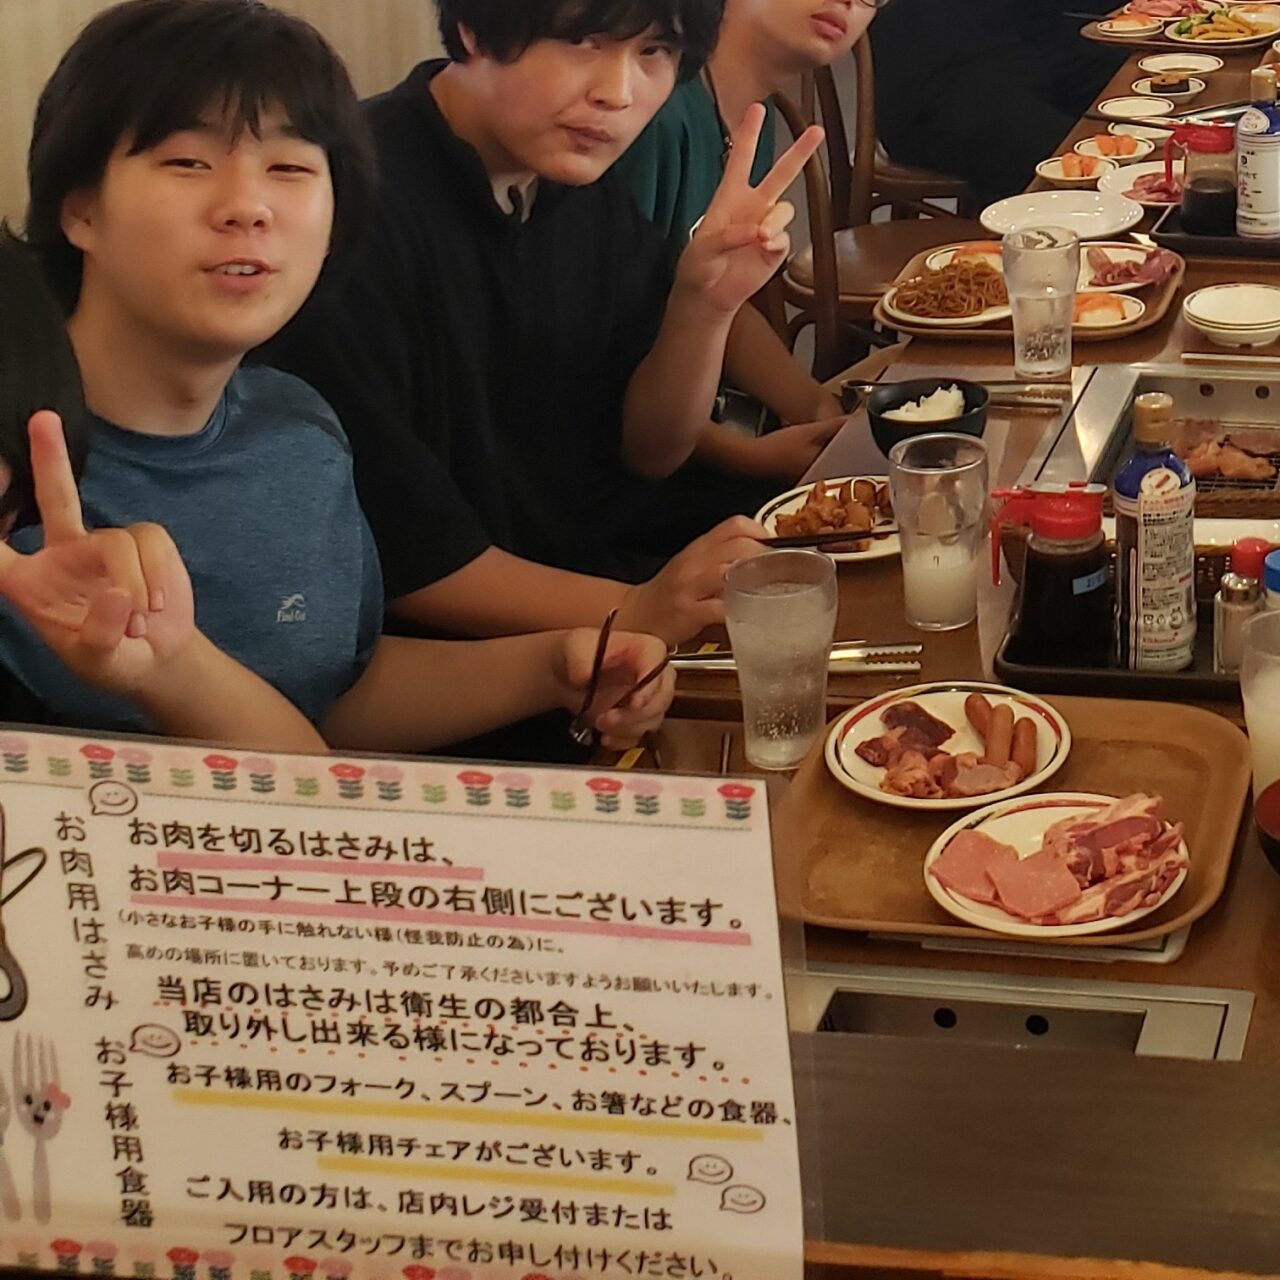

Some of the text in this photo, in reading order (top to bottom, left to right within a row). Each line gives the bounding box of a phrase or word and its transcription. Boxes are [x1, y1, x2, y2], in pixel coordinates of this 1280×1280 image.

[128, 817, 454, 866] お肉を切るはさみは、
[54, 811, 120, 1011] お肉用はさみ
[128, 864, 743, 930] お肉コーナー上段の右側にございます。
[157, 975, 634, 1032] 当店のはさみは衛生の都合上、
[183, 1010, 725, 1071] 取り外し出来る様になっております。
[167, 1062, 791, 1126] お子様用のフォーク、スプーン、お箸などの食器、
[95, 1036, 154, 1228] お子様用食器
[278, 1127, 657, 1176] お子様用チェアがございます。
[186, 1174, 673, 1231] ご入用の方は、店内レジ受付または
[225, 1222, 733, 1280] フロアスタッフまでお申し付けください。
